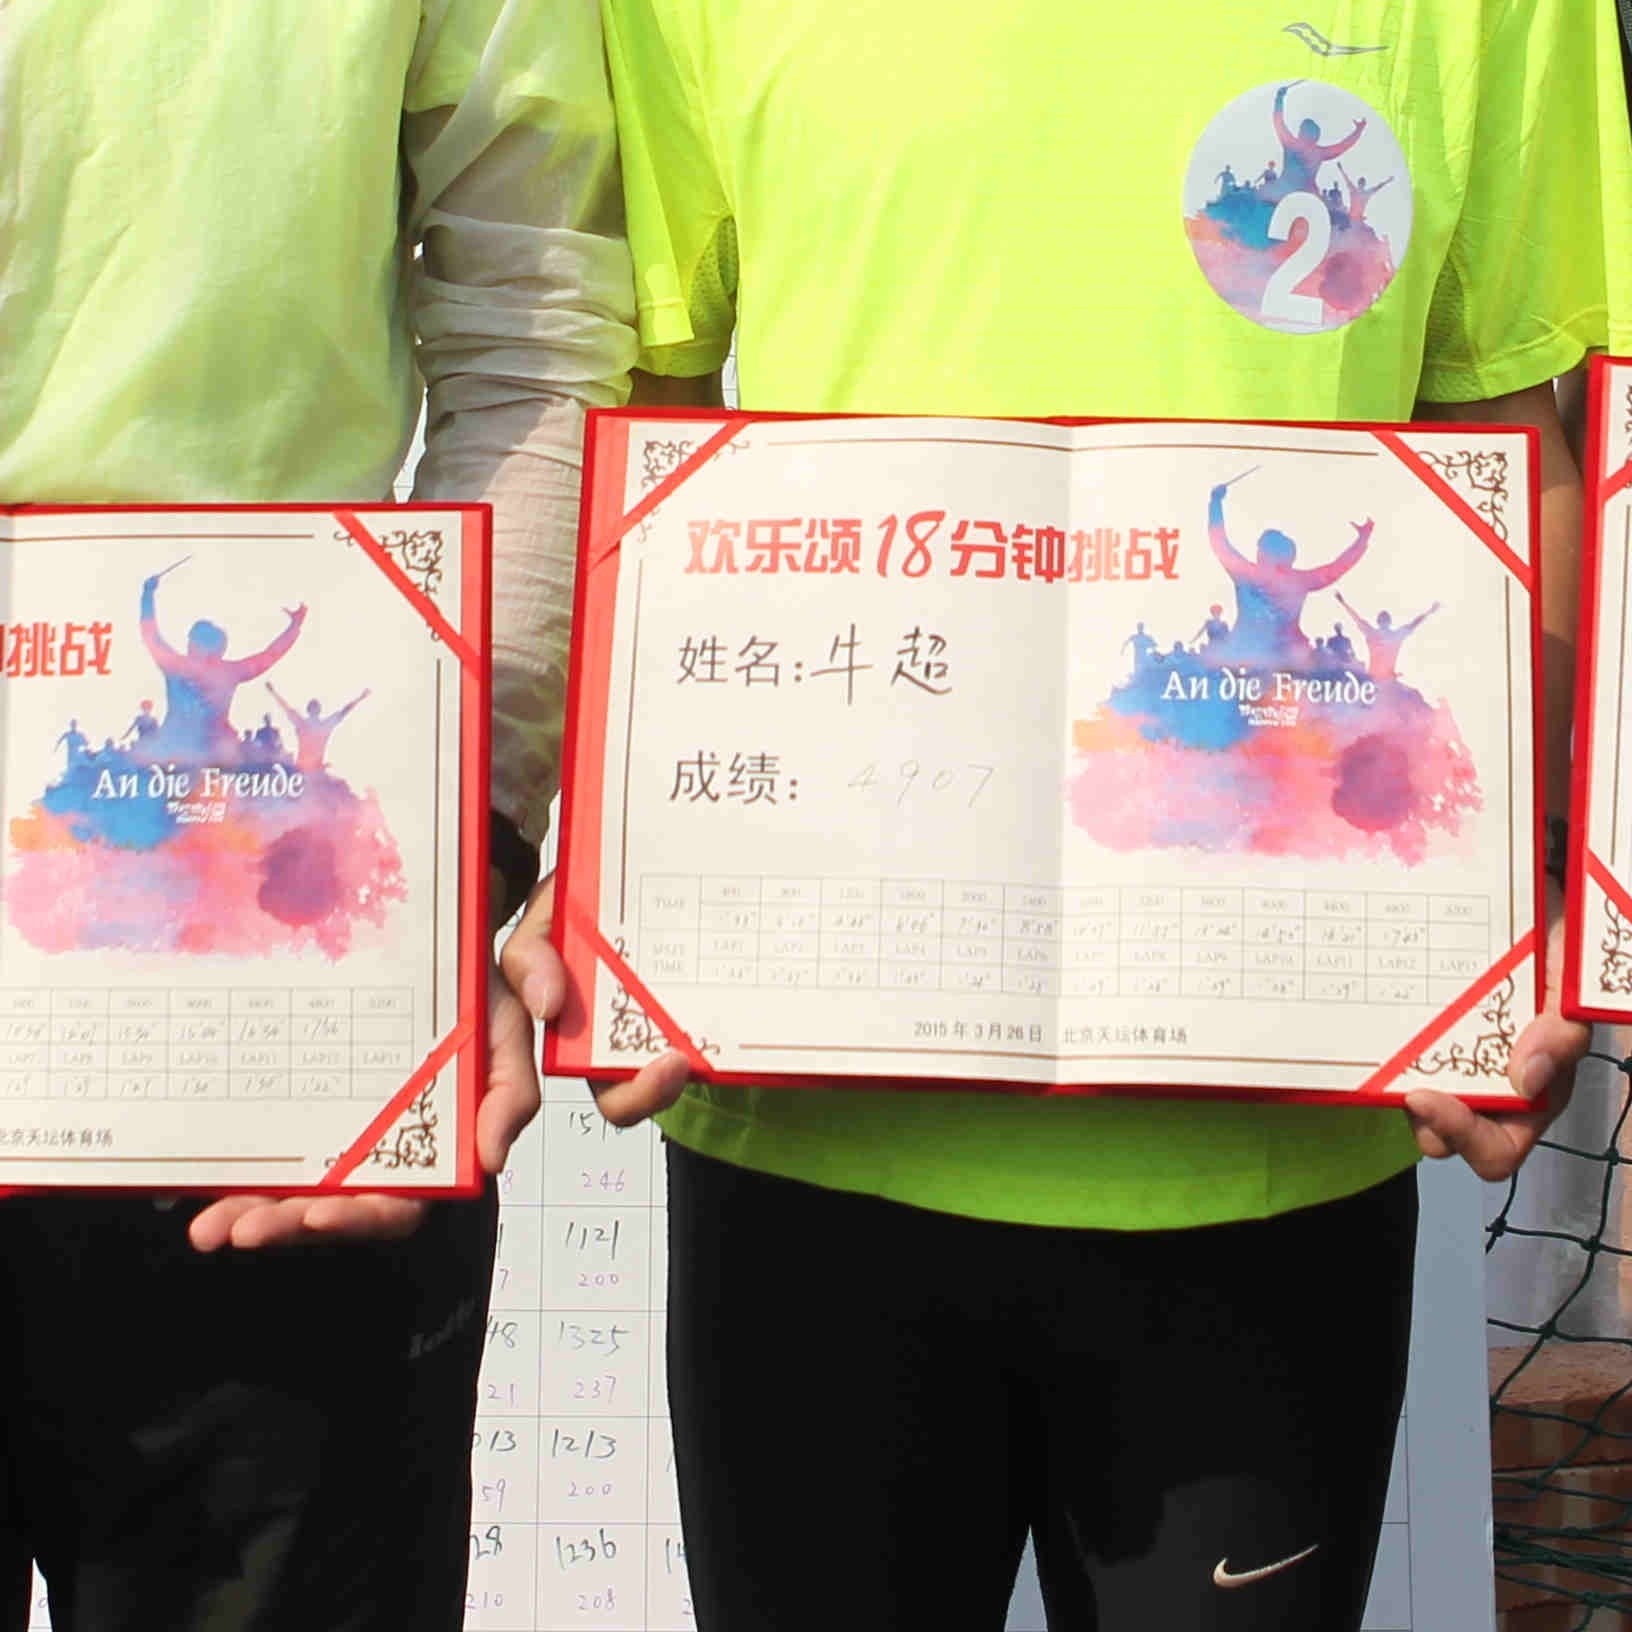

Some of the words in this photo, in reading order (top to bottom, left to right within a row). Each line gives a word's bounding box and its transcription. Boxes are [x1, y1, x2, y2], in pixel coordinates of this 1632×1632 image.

[1262, 191, 1331, 326] 2
[810, 623, 952, 706] 牛超
[1160, 671, 1209, 701] An
[1219, 667, 1262, 701] die
[1272, 671, 1376, 704] Freude
[91, 768, 138, 799] An
[148, 763, 191, 798] die
[200, 763, 304, 798] Freude
[573, 1375, 616, 1404] 237
[552, 1428, 617, 1459] 1213
